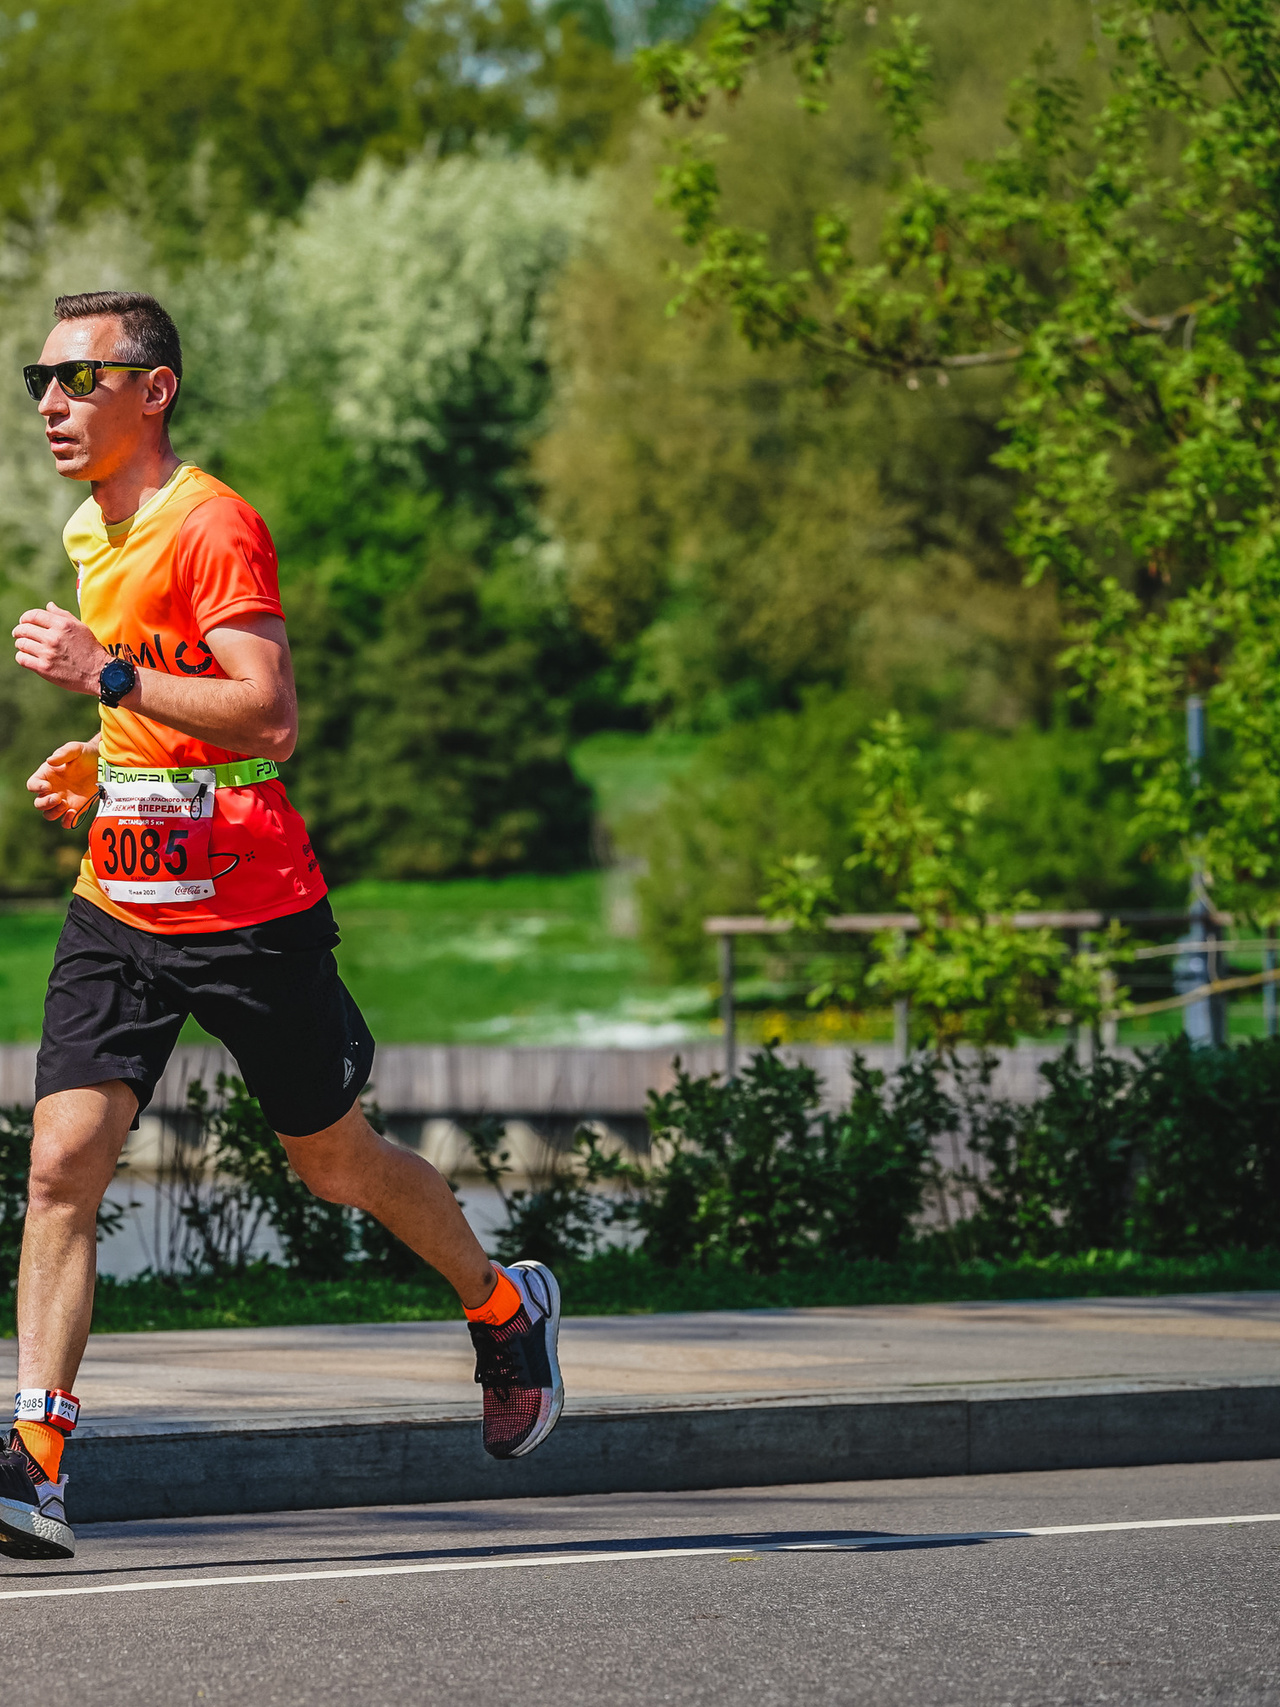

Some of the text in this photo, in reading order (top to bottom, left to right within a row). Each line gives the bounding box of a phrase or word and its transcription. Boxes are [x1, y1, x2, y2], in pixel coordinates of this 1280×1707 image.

[137, 804, 182, 814] ВПЕРЕДИ
[102, 828, 189, 876] 3085
[22, 1397, 44, 1409] 3085
